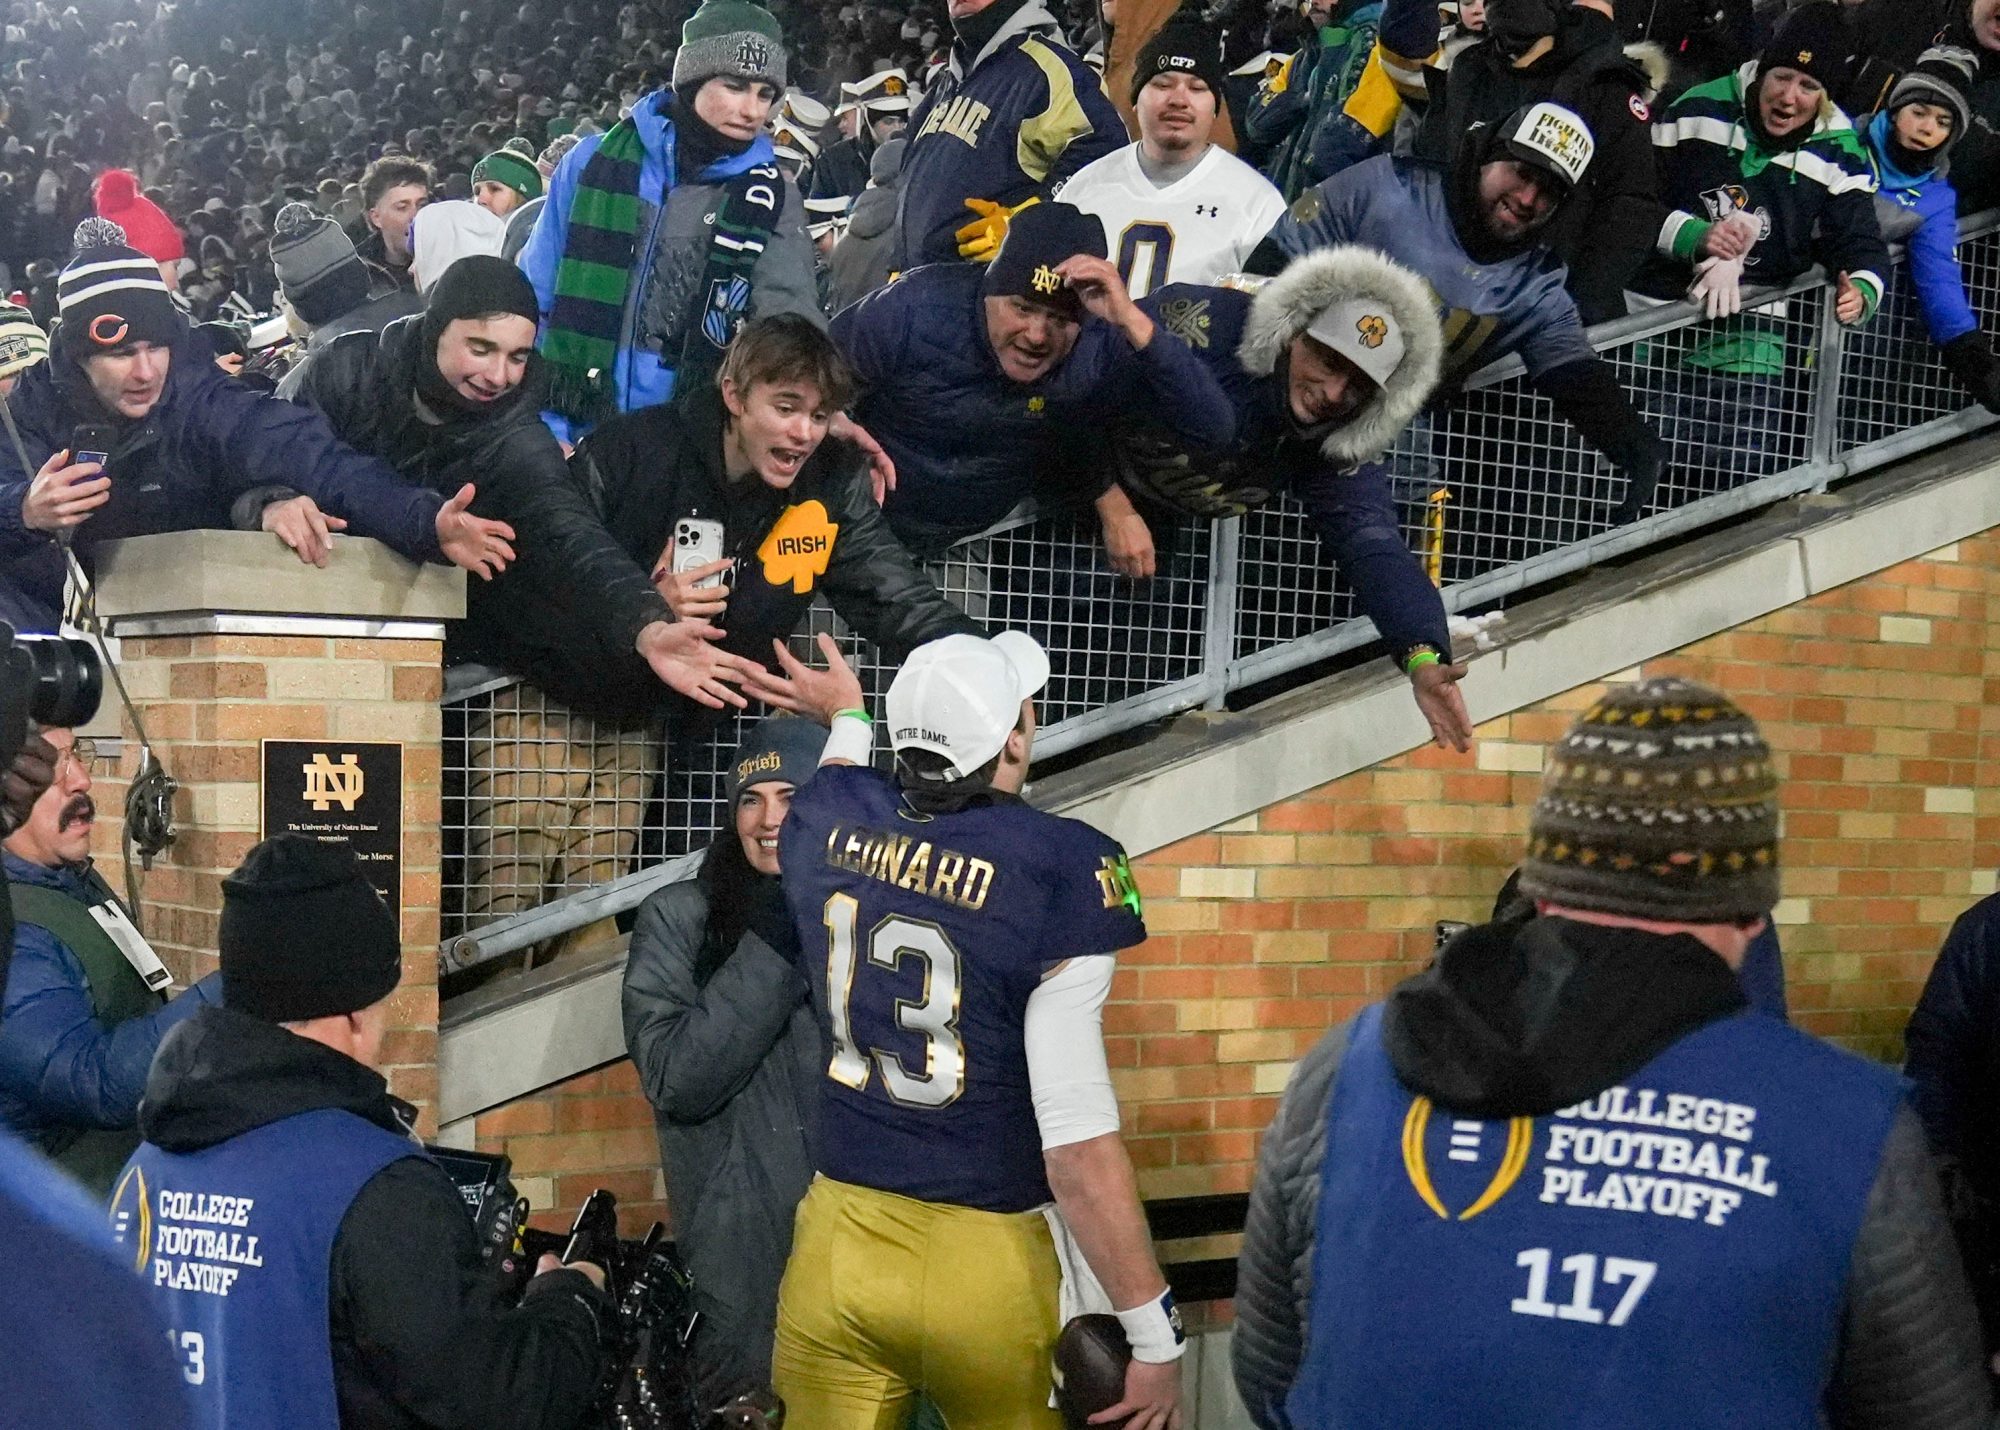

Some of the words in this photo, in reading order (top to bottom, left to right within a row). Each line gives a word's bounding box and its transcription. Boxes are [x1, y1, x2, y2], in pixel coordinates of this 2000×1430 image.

[1169, 55, 1196, 69] CFP
[89, 313, 129, 346] C
[777, 535, 827, 556] IRISH
[895, 727, 919, 742] NOTRE
[303, 753, 364, 811] ND
[737, 751, 782, 784] Irish
[288, 823, 301, 831] The
[302, 823, 332, 832] University
[334, 823, 341, 831] of
[371, 852, 394, 861] Morse
[825, 827, 995, 910] LEONARD
[823, 891, 965, 1110] 13
[1545, 1124, 1778, 1198] FOOTBALL
[158, 1190, 254, 1228] COLLEGE
[1539, 1166, 1742, 1226] PLAYOFF
[156, 1224, 263, 1267] FOOTBALL
[154, 1258, 239, 1296] PLAYOFF
[1510, 1247, 1658, 1327] 117
